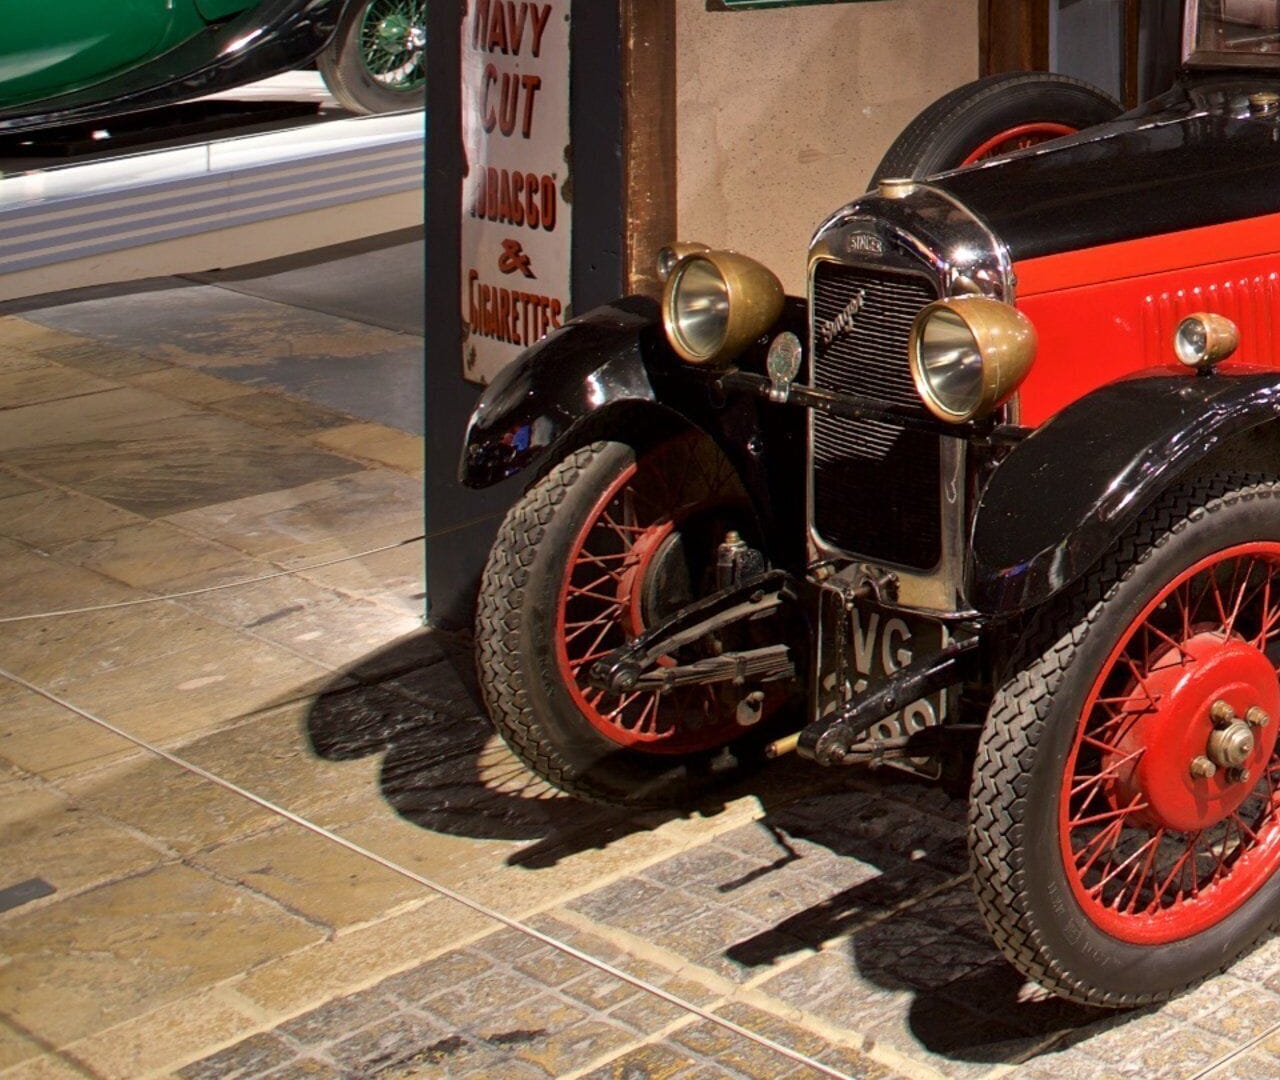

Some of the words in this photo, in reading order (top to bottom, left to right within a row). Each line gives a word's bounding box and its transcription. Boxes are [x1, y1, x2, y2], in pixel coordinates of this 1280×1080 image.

[479, 62, 541, 139] CUT
[469, 160, 557, 232] OBACCO
[498, 238, 537, 281] &
[851, 606, 913, 676] VG
